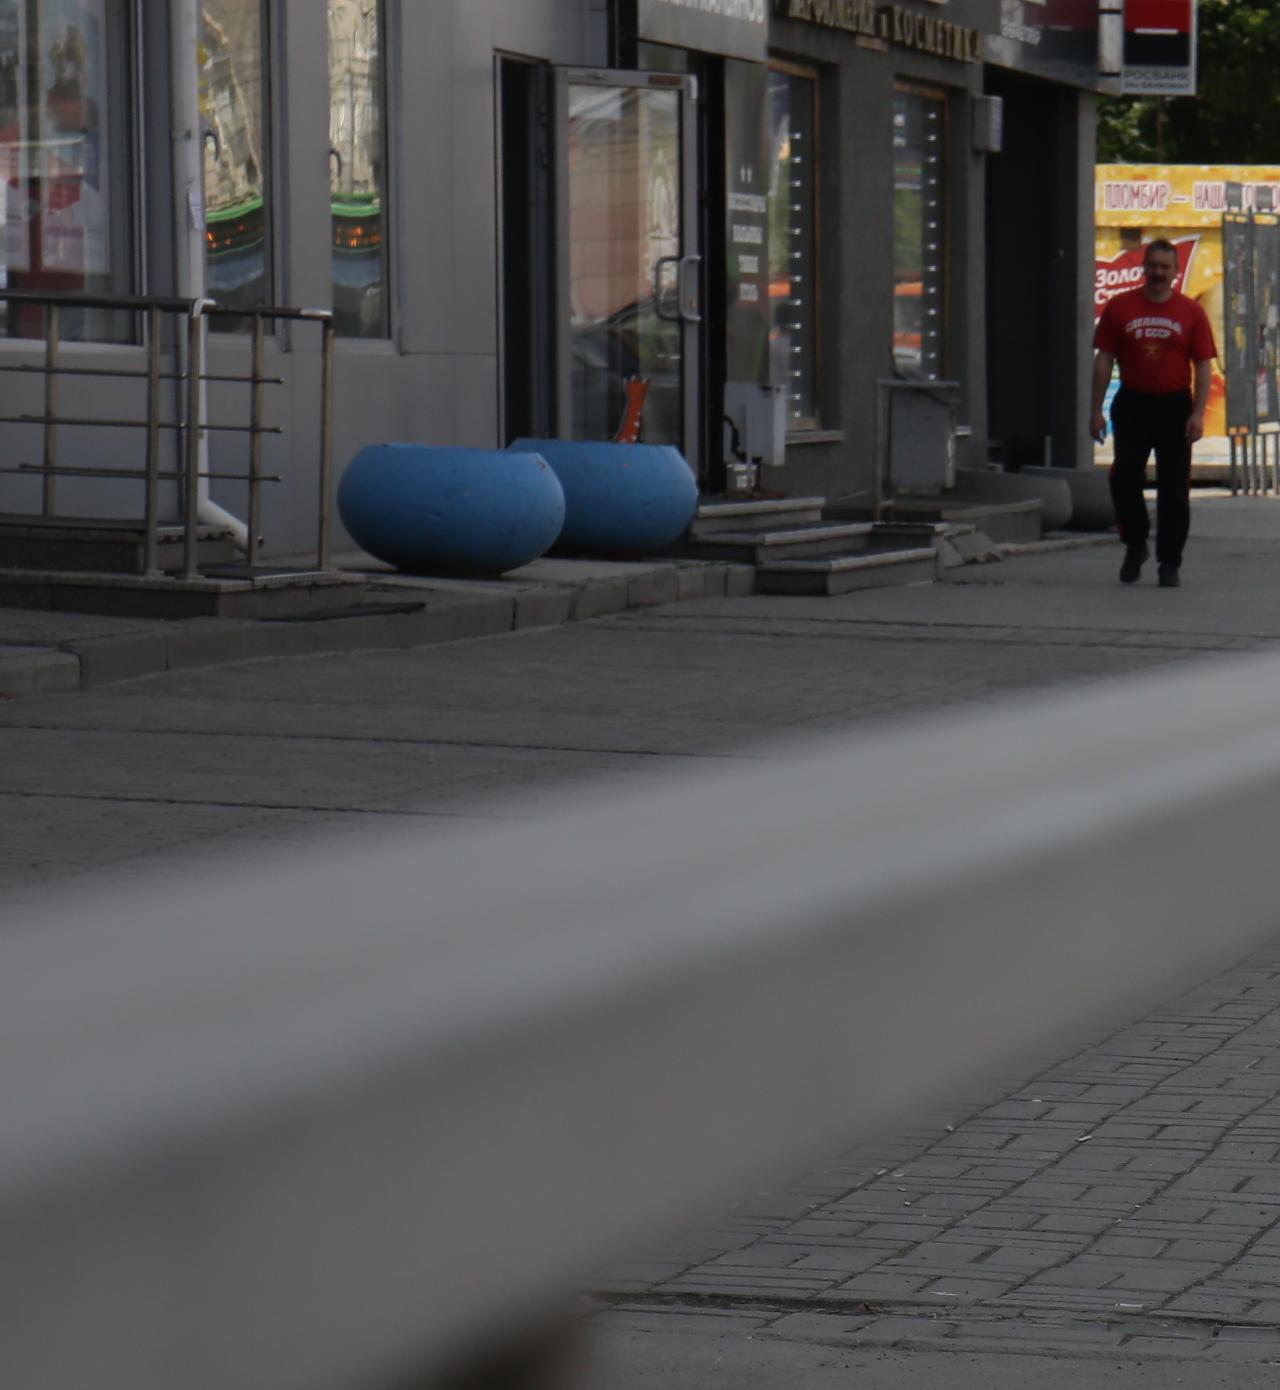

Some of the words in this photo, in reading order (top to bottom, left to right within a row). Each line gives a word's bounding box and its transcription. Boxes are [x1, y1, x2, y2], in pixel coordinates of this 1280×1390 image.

[893, 6, 982, 64] КОСМЕТИКА
[1123, 70, 1189, 80] РОСБАНК
[1105, 183, 1168, 210] ПЛОМБИР
[1195, 184, 1226, 210] НАШ
